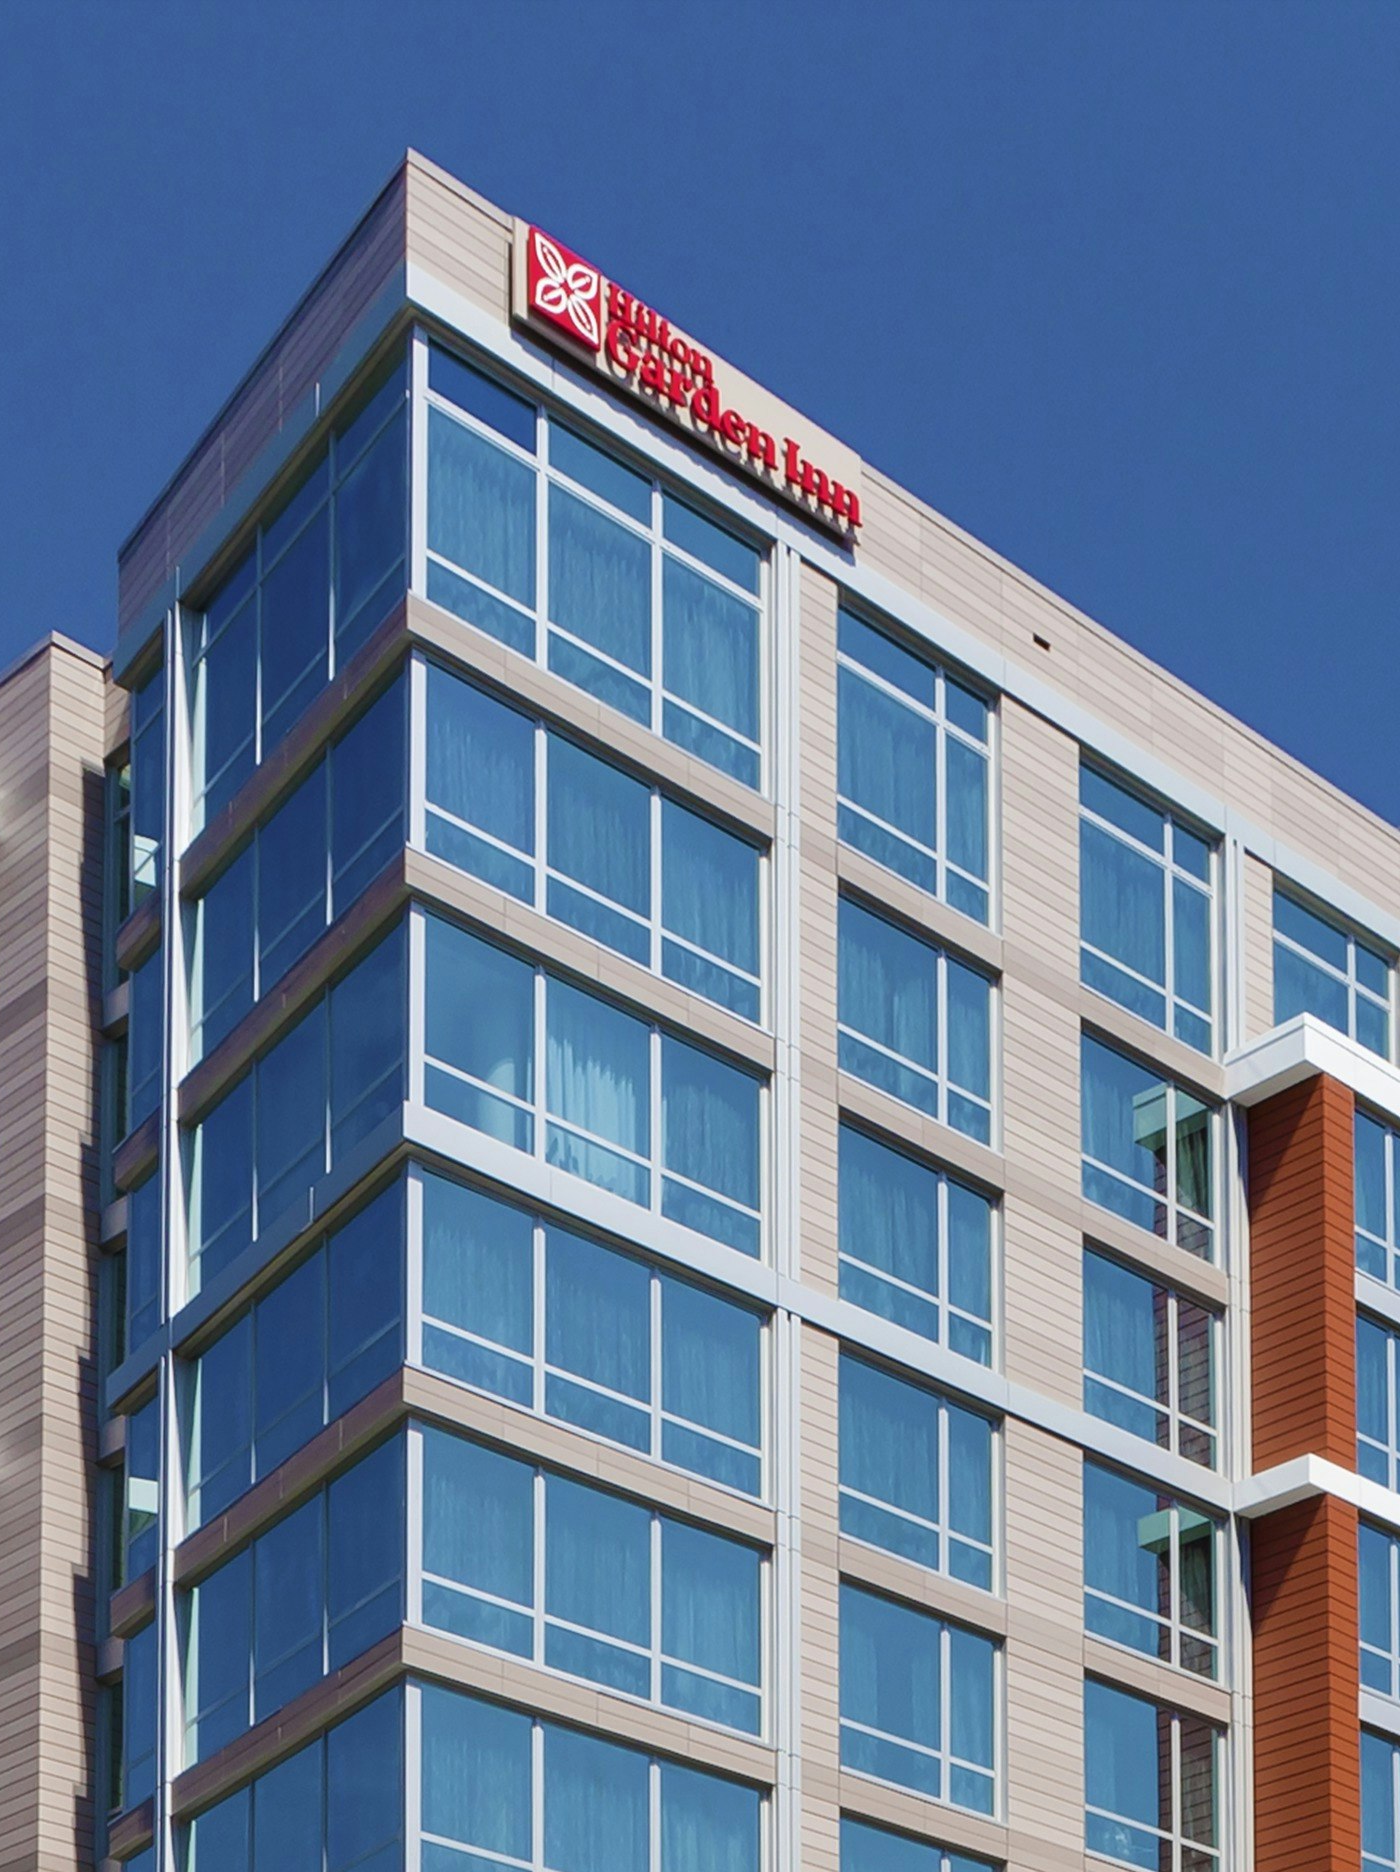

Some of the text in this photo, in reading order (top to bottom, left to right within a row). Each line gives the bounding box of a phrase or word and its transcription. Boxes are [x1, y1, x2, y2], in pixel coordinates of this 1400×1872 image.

[606, 283, 714, 381] Hilton
[605, 319, 864, 528] Garden Inn
